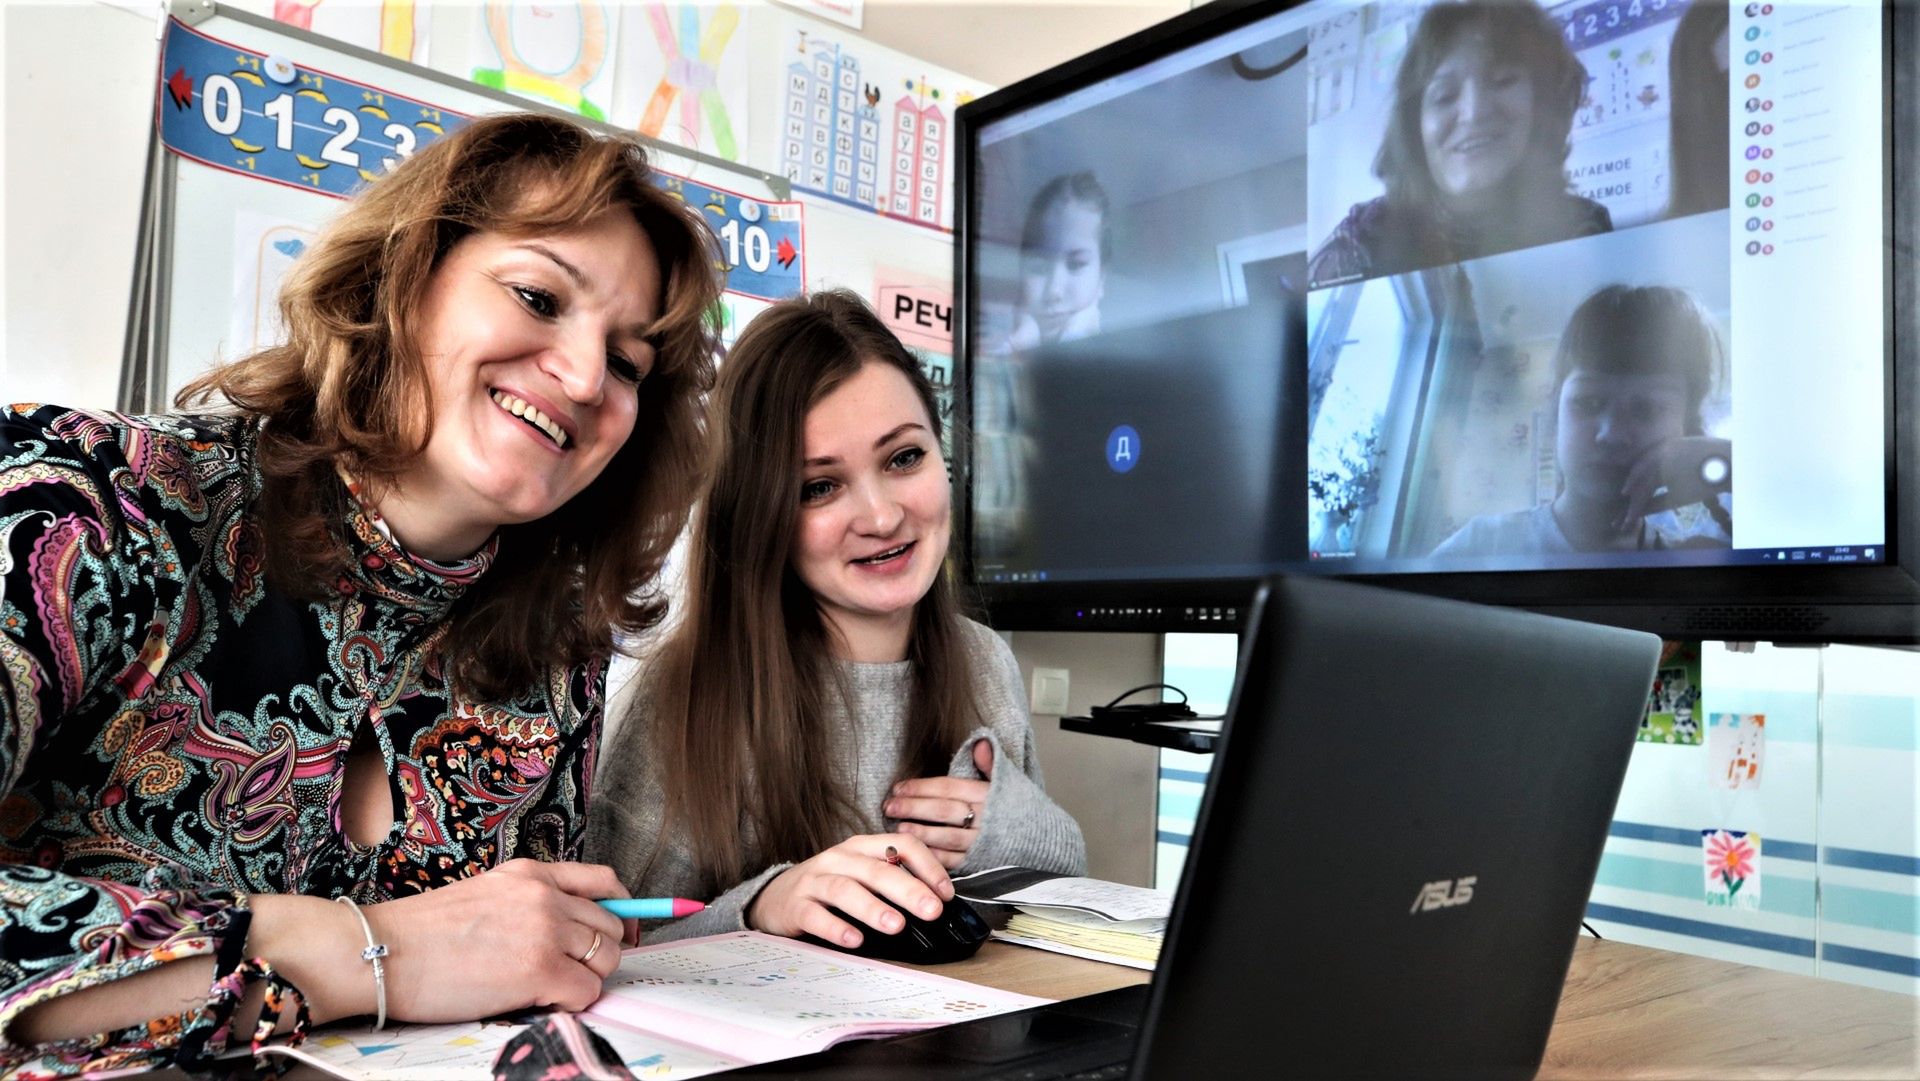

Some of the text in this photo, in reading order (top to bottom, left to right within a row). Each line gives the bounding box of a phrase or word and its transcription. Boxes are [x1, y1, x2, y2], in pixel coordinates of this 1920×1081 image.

[1564, 22, 1576, 41] 1
[1584, 13, 1598, 36] 2
[1606, 5, 1621, 27] 3
[1627, 0, 1643, 18] 4
[235, 55, 259, 72] +1
[300, 74, 325, 90] +1
[362, 91, 384, 106] +1
[420, 108, 441, 122] +1
[202, 74, 770, 272] 0 1 2 3 10
[236, 156, 320, 187] -1 -1
[1115, 436, 1131, 462] Д
[1410, 876, 1478, 915] ASUS
